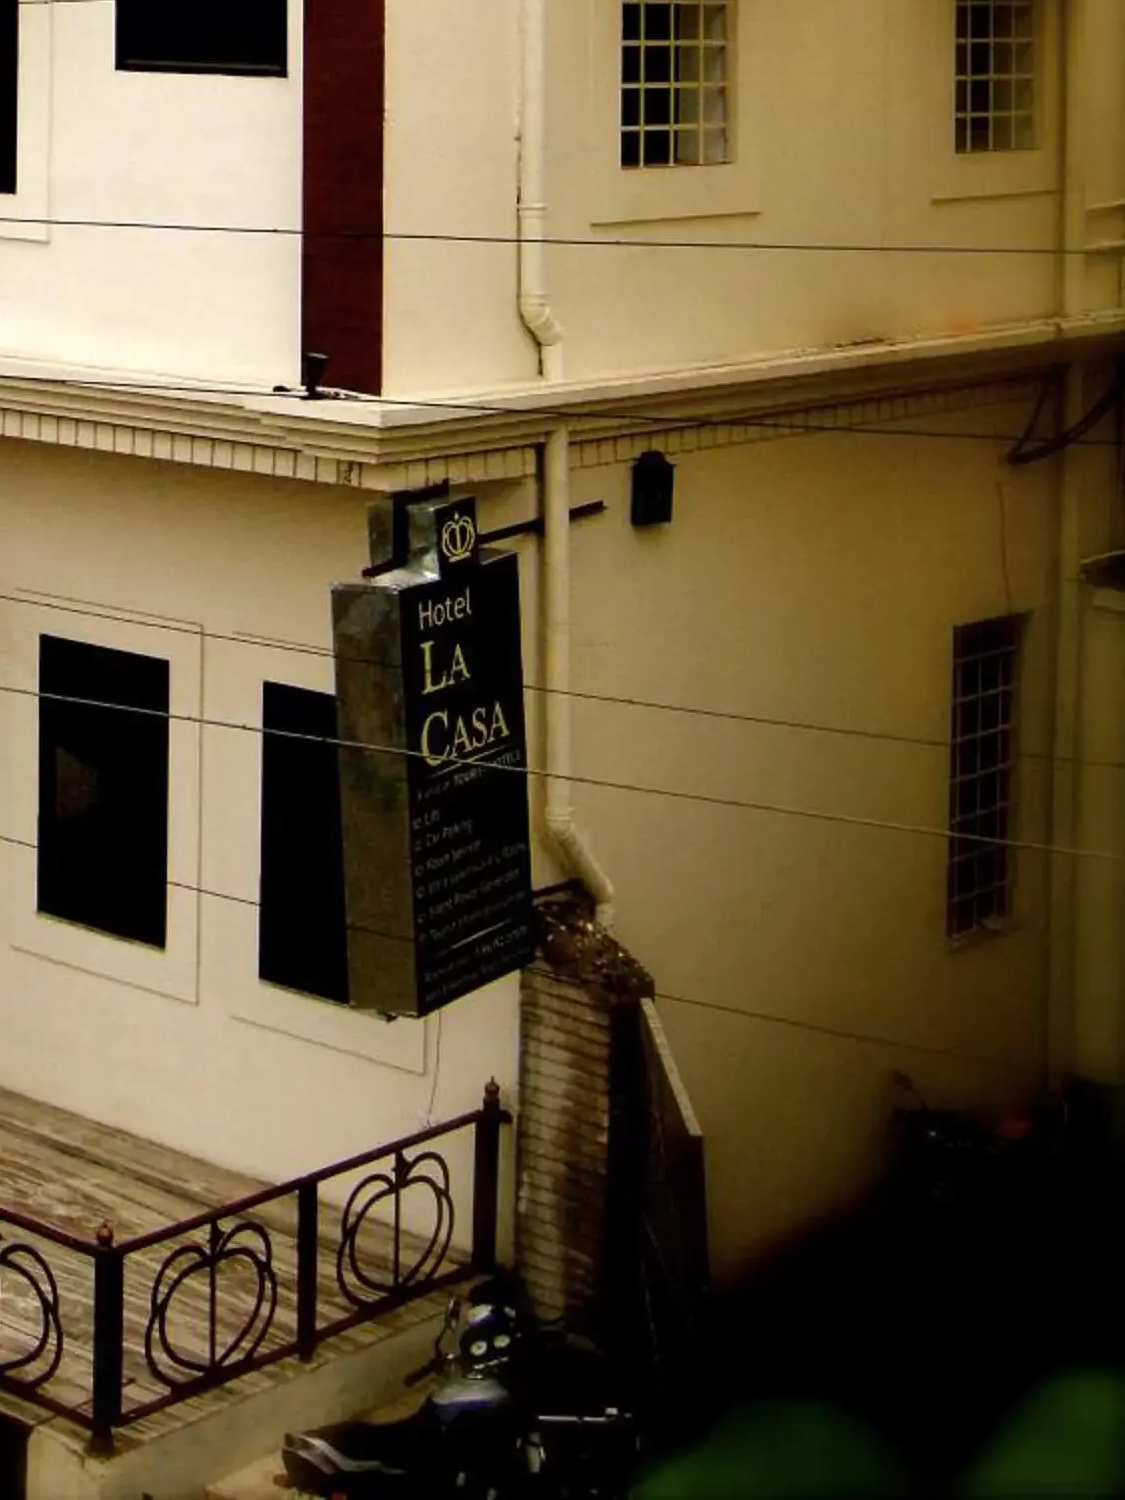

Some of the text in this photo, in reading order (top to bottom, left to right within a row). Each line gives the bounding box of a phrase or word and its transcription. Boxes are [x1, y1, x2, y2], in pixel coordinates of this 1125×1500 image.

[418, 586, 472, 631] Hotel
[420, 640, 471, 695] LA
[420, 700, 510, 767] CASA
